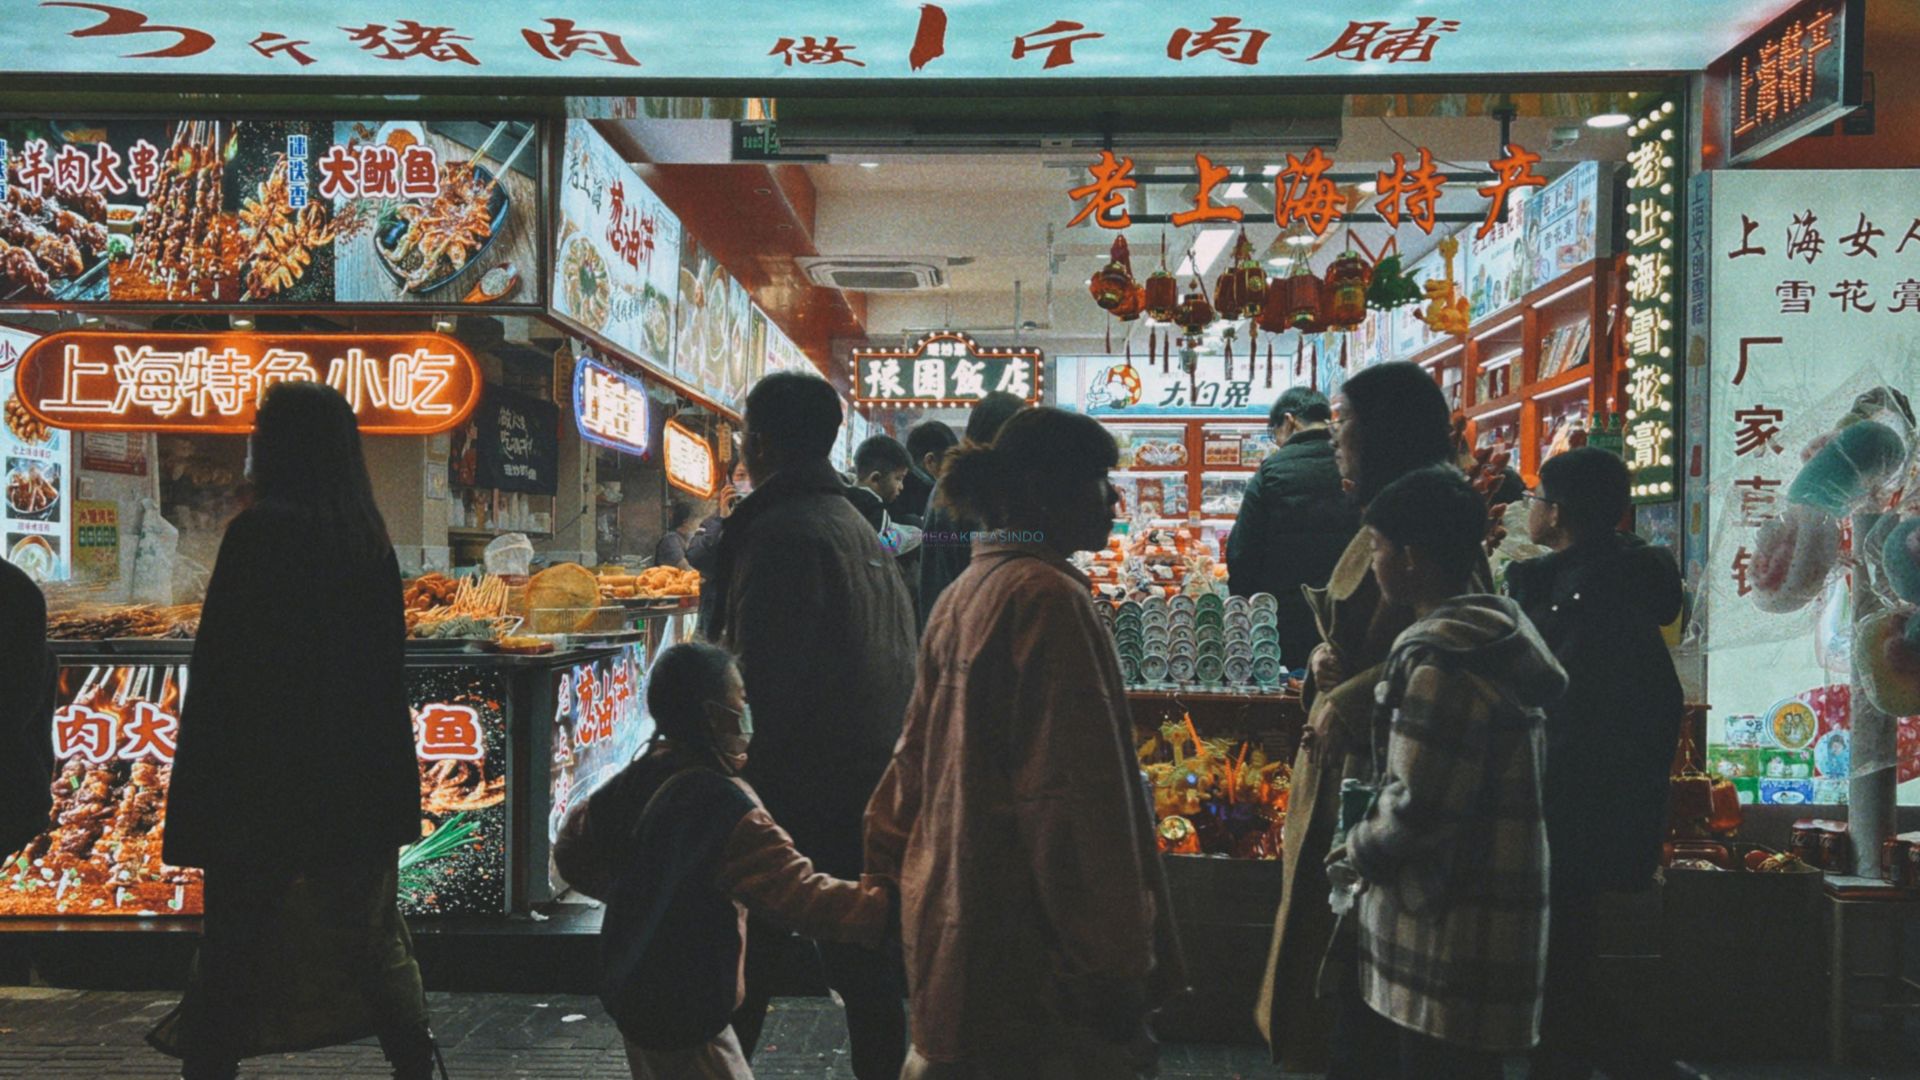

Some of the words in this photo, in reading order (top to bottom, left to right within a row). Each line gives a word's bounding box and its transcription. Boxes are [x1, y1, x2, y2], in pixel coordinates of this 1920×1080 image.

[19, 138, 159, 198] 羊肉大串
[287, 135, 307, 208] 迷迭香
[319, 145, 440, 198] 大鱿鱼
[1066, 144, 1548, 240] 老上海特产
[1631, 140, 1664, 469] 老上海雪花膏
[1776, 278, 1920, 313] 雪花膏
[1158, 380, 1253, 408] 大白兔
